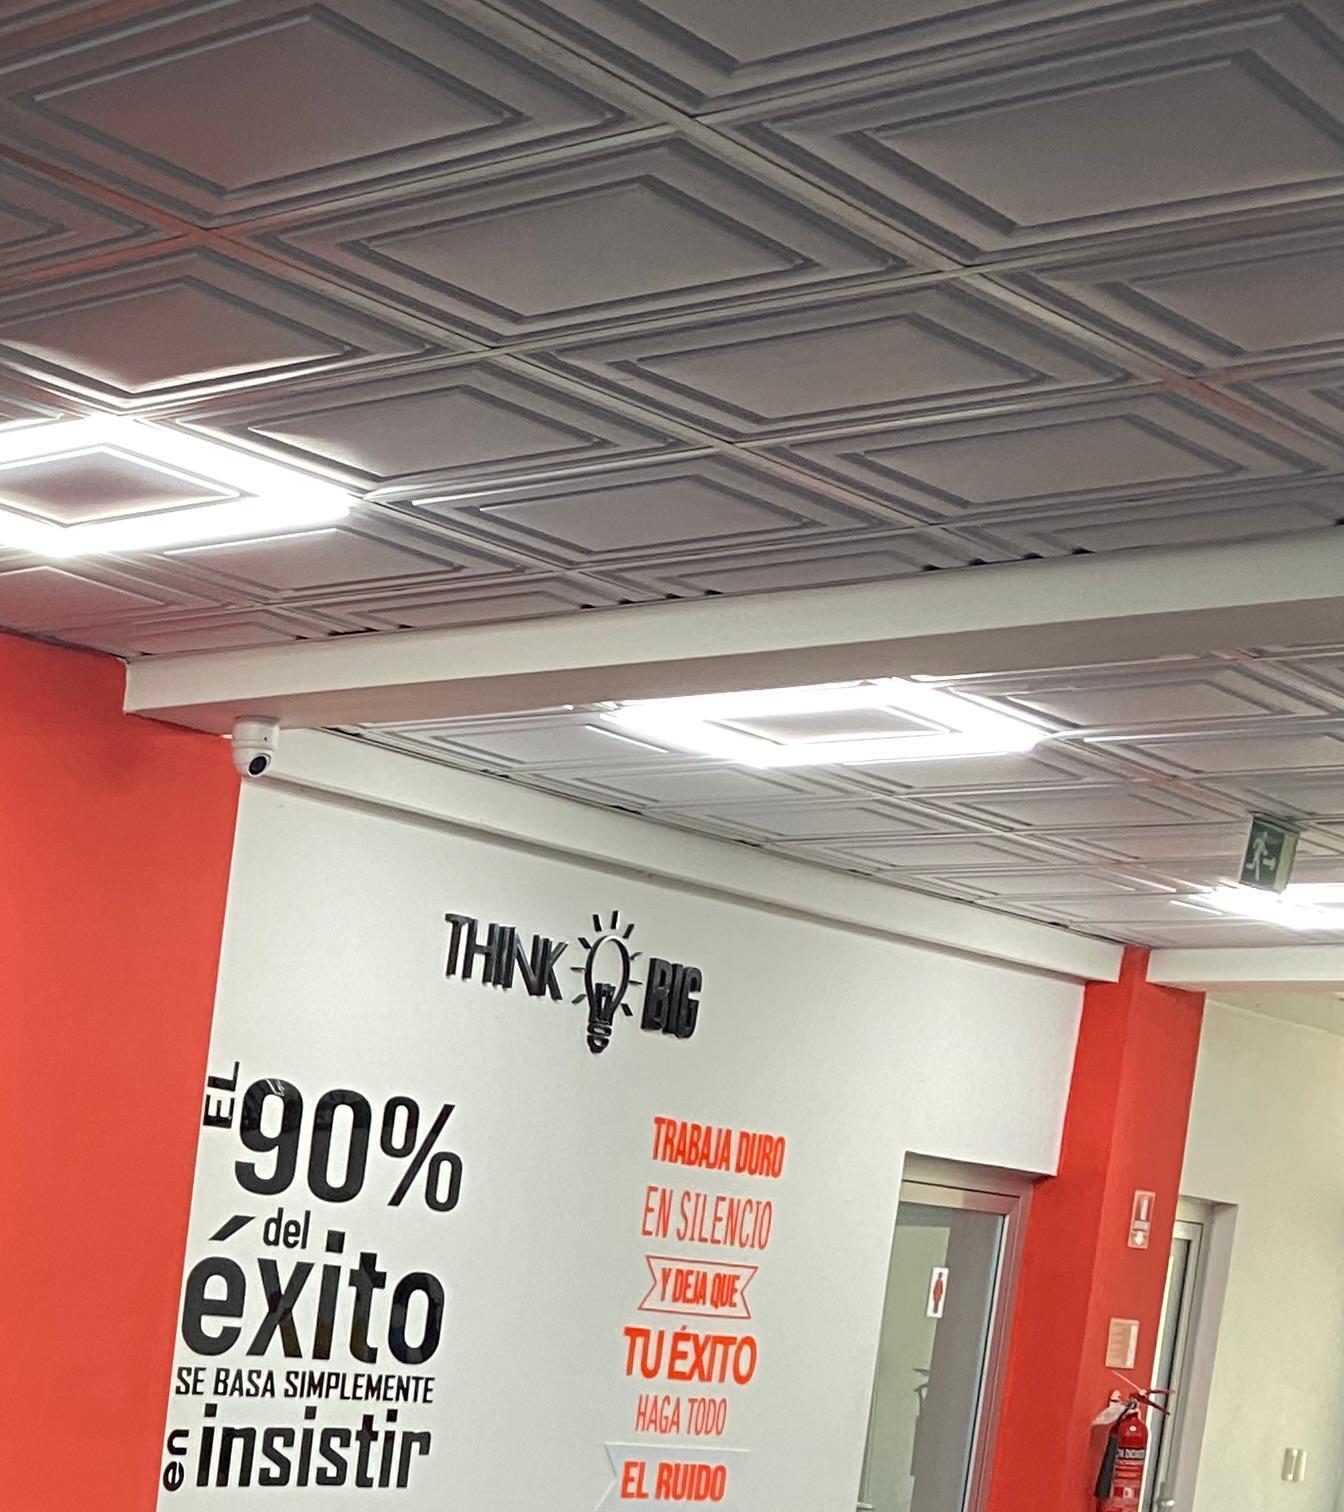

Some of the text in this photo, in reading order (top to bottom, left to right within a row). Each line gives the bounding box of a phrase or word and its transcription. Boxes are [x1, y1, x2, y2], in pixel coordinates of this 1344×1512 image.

[444, 913, 703, 1040] THINK BIG
[203, 1061, 240, 1128] EL
[235, 1079, 463, 1213] 90%
[652, 1116, 786, 1179] TRABAJA DURO
[263, 1207, 311, 1249] del
[642, 1185, 773, 1250] EN SILENCIO
[181, 1215, 445, 1365] éxito
[660, 1267, 741, 1309] Y DEJA QUE
[176, 1366, 435, 1404] SE BASA SIMPLEMENTE
[623, 1324, 758, 1385] TU ÉXITO
[197, 1402, 431, 1489] insistir
[635, 1394, 728, 1436] HAGA TODO
[162, 1429, 189, 1491] en
[620, 1460, 728, 1503] EL RUIDO
